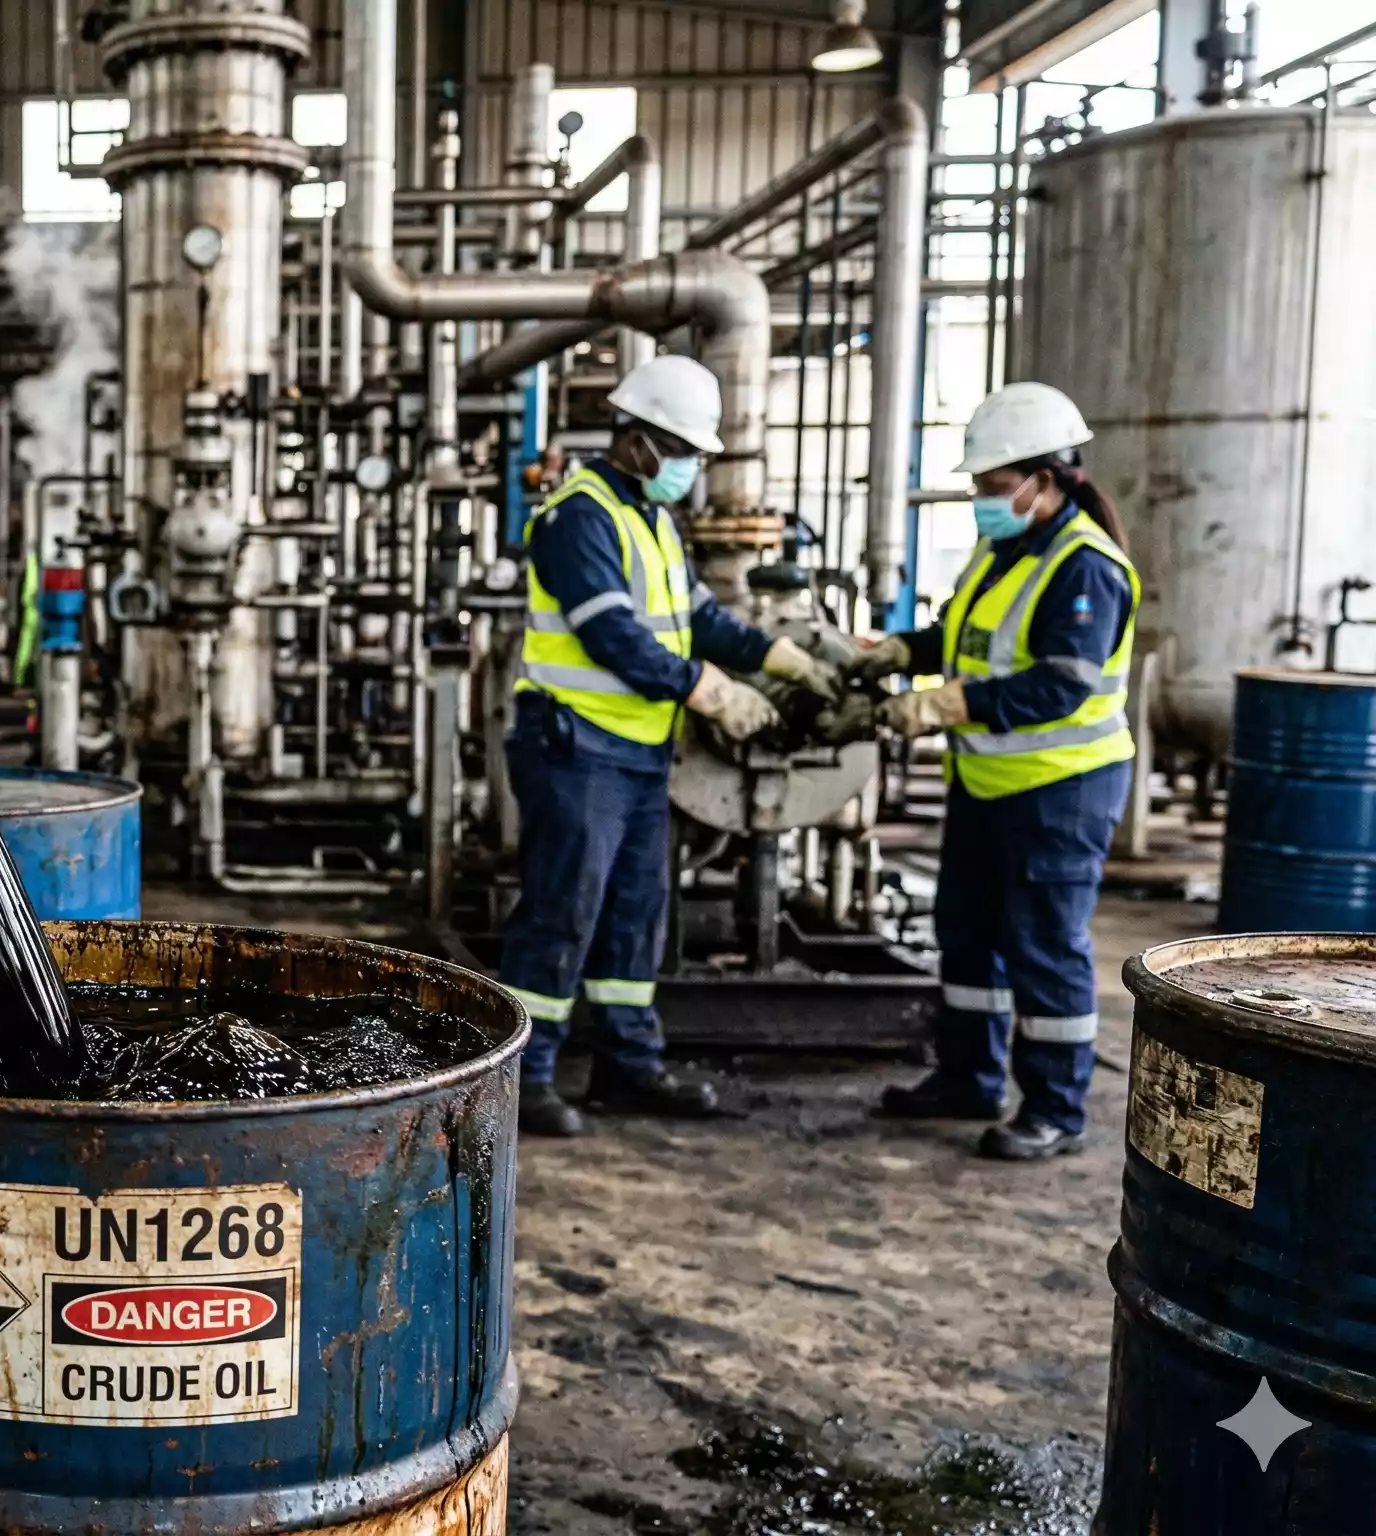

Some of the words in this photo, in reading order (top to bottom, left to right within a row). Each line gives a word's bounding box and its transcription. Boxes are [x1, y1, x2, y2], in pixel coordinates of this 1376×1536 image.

[54, 1202, 285, 1263] UN1268
[91, 1298, 251, 1331] DANGER
[61, 1364, 201, 1402] CRUDE
[215, 1360, 277, 1399] OIL
